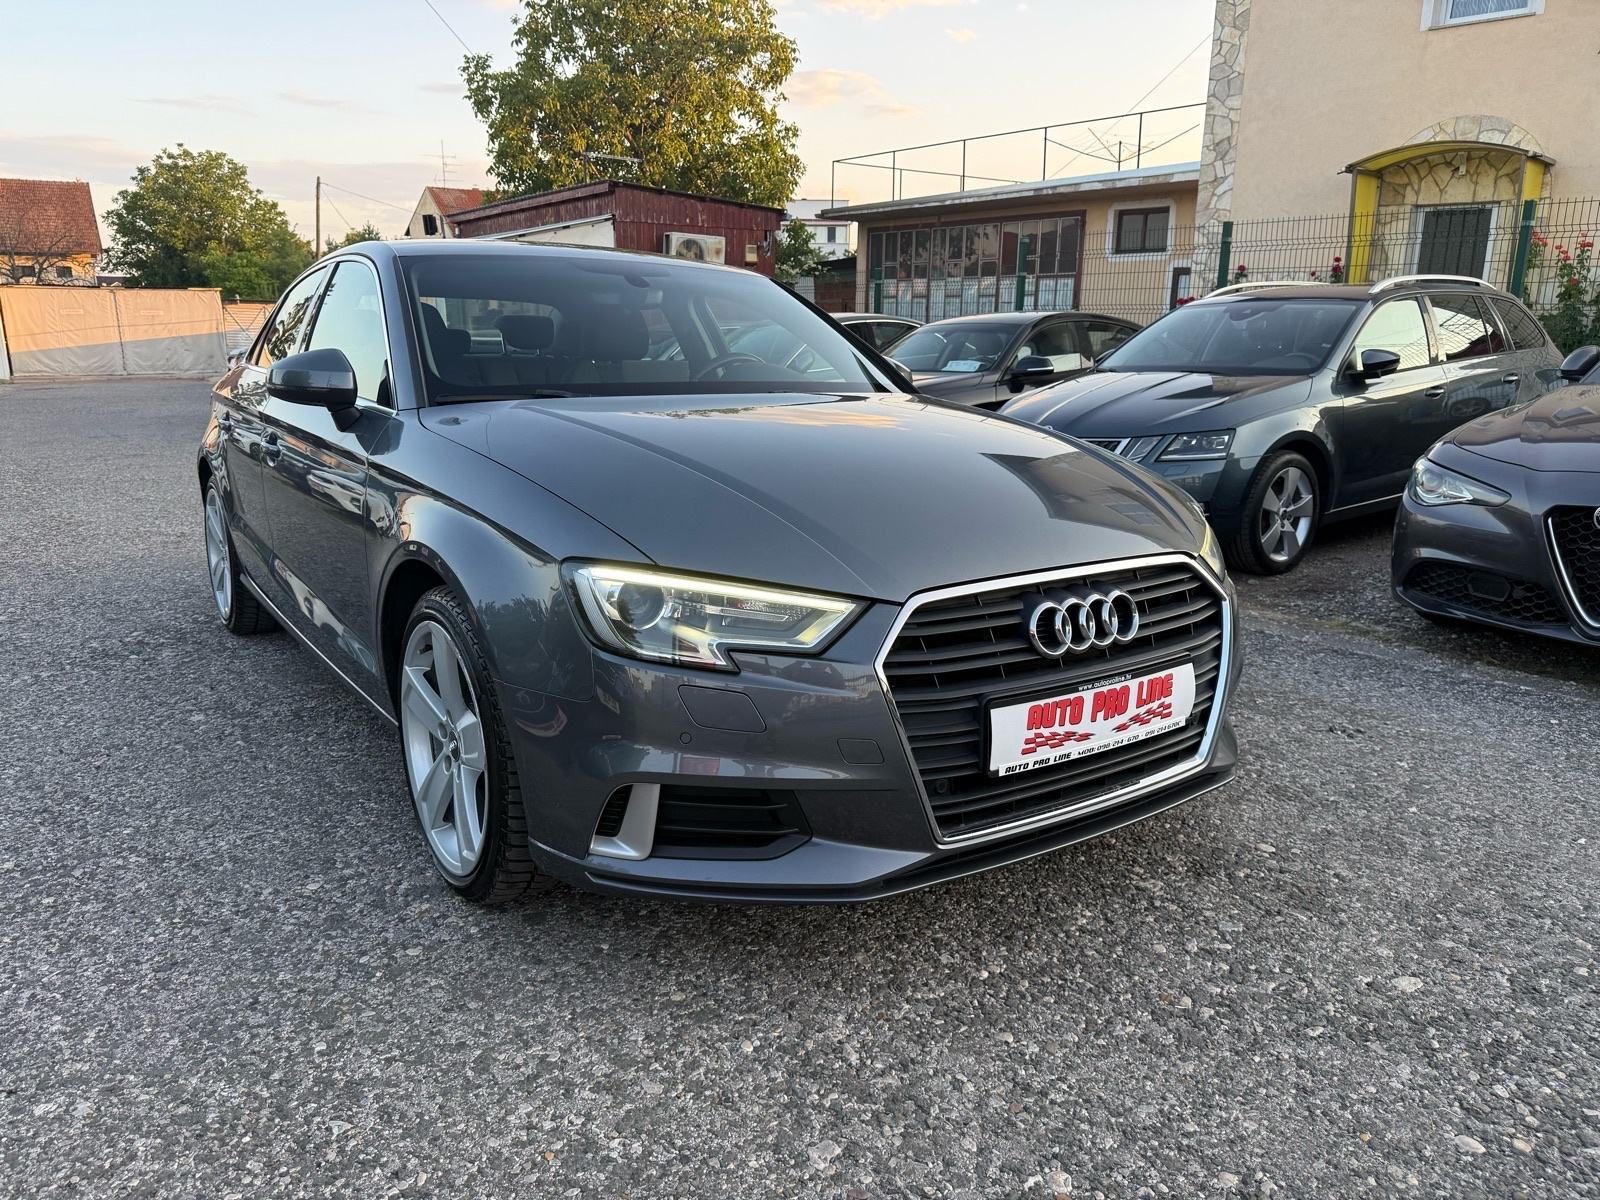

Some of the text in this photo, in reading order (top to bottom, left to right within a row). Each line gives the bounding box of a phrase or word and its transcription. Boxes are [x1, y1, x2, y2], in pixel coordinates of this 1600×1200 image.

[1026, 672, 1174, 731] AUTO PRO LINE
[1005, 762, 1030, 774] AUTO
[1032, 757, 1051, 768] PRO
[1053, 751, 1072, 763] LINE
[1112, 738, 1124, 747] 214
[1126, 734, 1140, 743] 670
